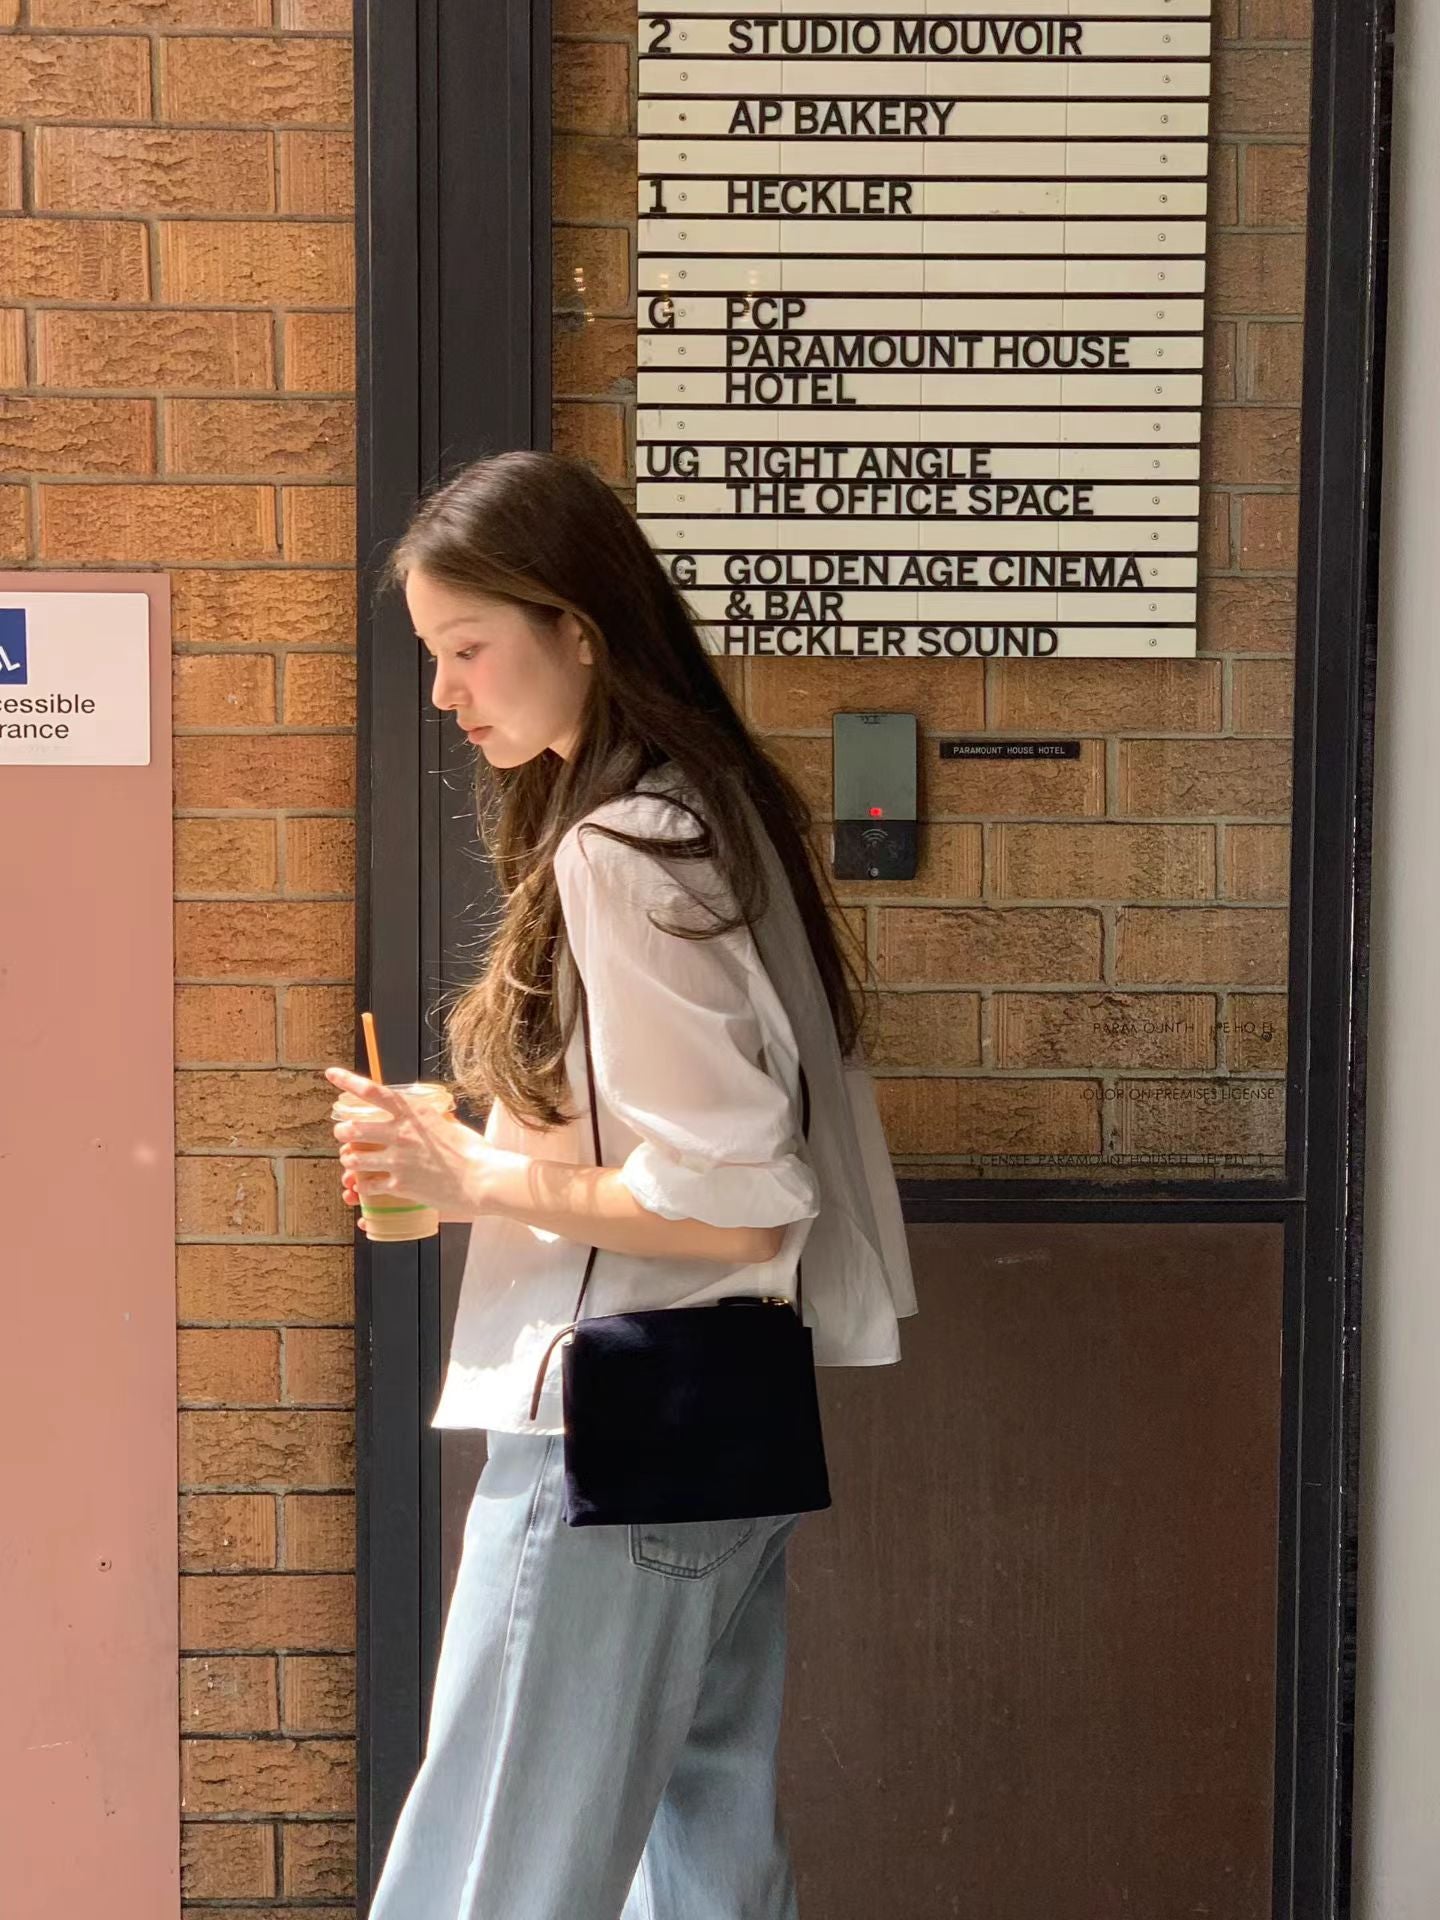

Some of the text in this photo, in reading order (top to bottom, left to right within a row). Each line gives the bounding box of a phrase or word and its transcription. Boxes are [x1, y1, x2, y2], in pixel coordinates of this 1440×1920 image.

[648, 20, 672, 54] 2
[728, 20, 1083, 56] STUDIO MOUVOIR
[728, 101, 955, 136] AP BAKERY
[649, 179, 667, 214] 1
[727, 180, 913, 214] HECKLER
[648, 297, 675, 329] G
[725, 297, 806, 329] PCP
[725, 335, 1130, 368] PARAMOUNT HOUSE
[725, 372, 857, 405] HOTEL
[646, 446, 699, 477] UG
[724, 447, 992, 479] RIGHT ANGLE
[726, 483, 1094, 516] THE OFFICE SPACE
[670, 555, 697, 586] G
[723, 555, 1144, 588] GOLDEN AGE CINEMA
[724, 591, 844, 622] & BAR
[723, 626, 1059, 657] HECKLER SOUND
[0, 693, 95, 714] essible
[953, 746, 1066, 755] PARAMOUNT HOUSE HOTEL
[1221, 1087, 1275, 1101] LICENSE
